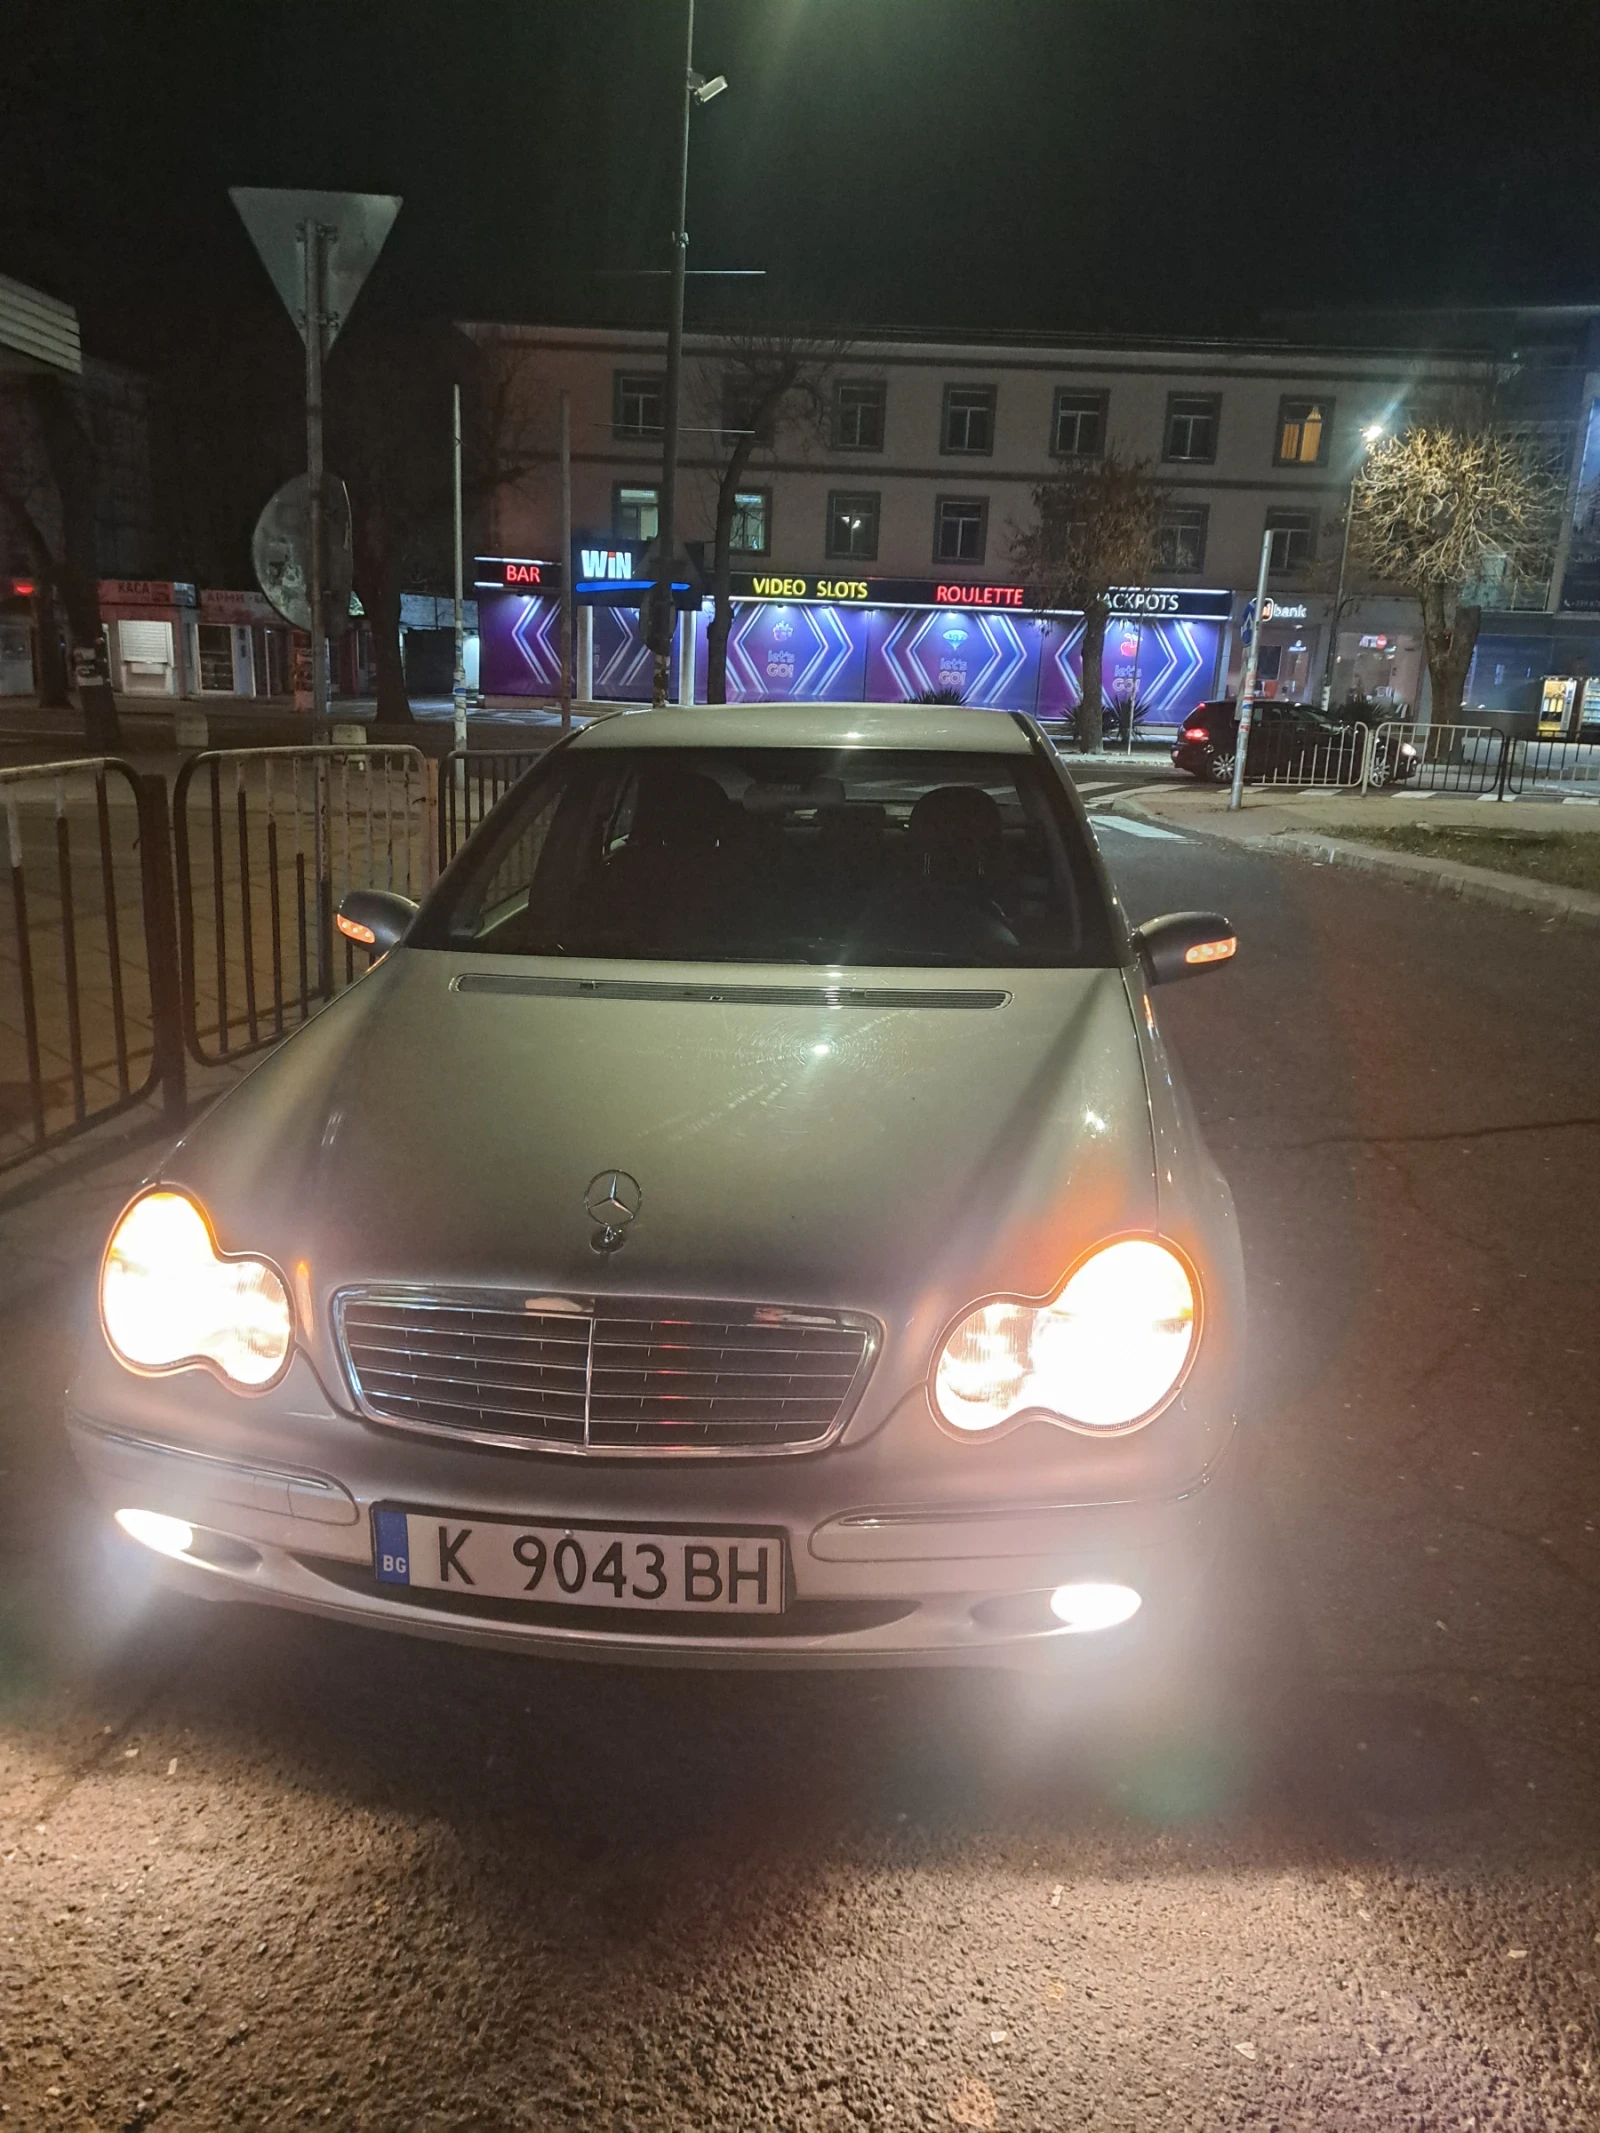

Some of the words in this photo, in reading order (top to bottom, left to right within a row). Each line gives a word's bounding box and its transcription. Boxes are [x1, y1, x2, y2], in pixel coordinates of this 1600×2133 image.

[506, 564, 541, 583] BAR
[752, 577, 806, 597] VIDEO
[816, 579, 868, 600] SLOTS
[935, 585, 1024, 606] ROULETTE
[1273, 603, 1307, 618] bank
[766, 663, 795, 678] GO!
[938, 671, 967, 686] GO!
[382, 1553, 407, 1574] BG
[438, 1526, 476, 1586] K
